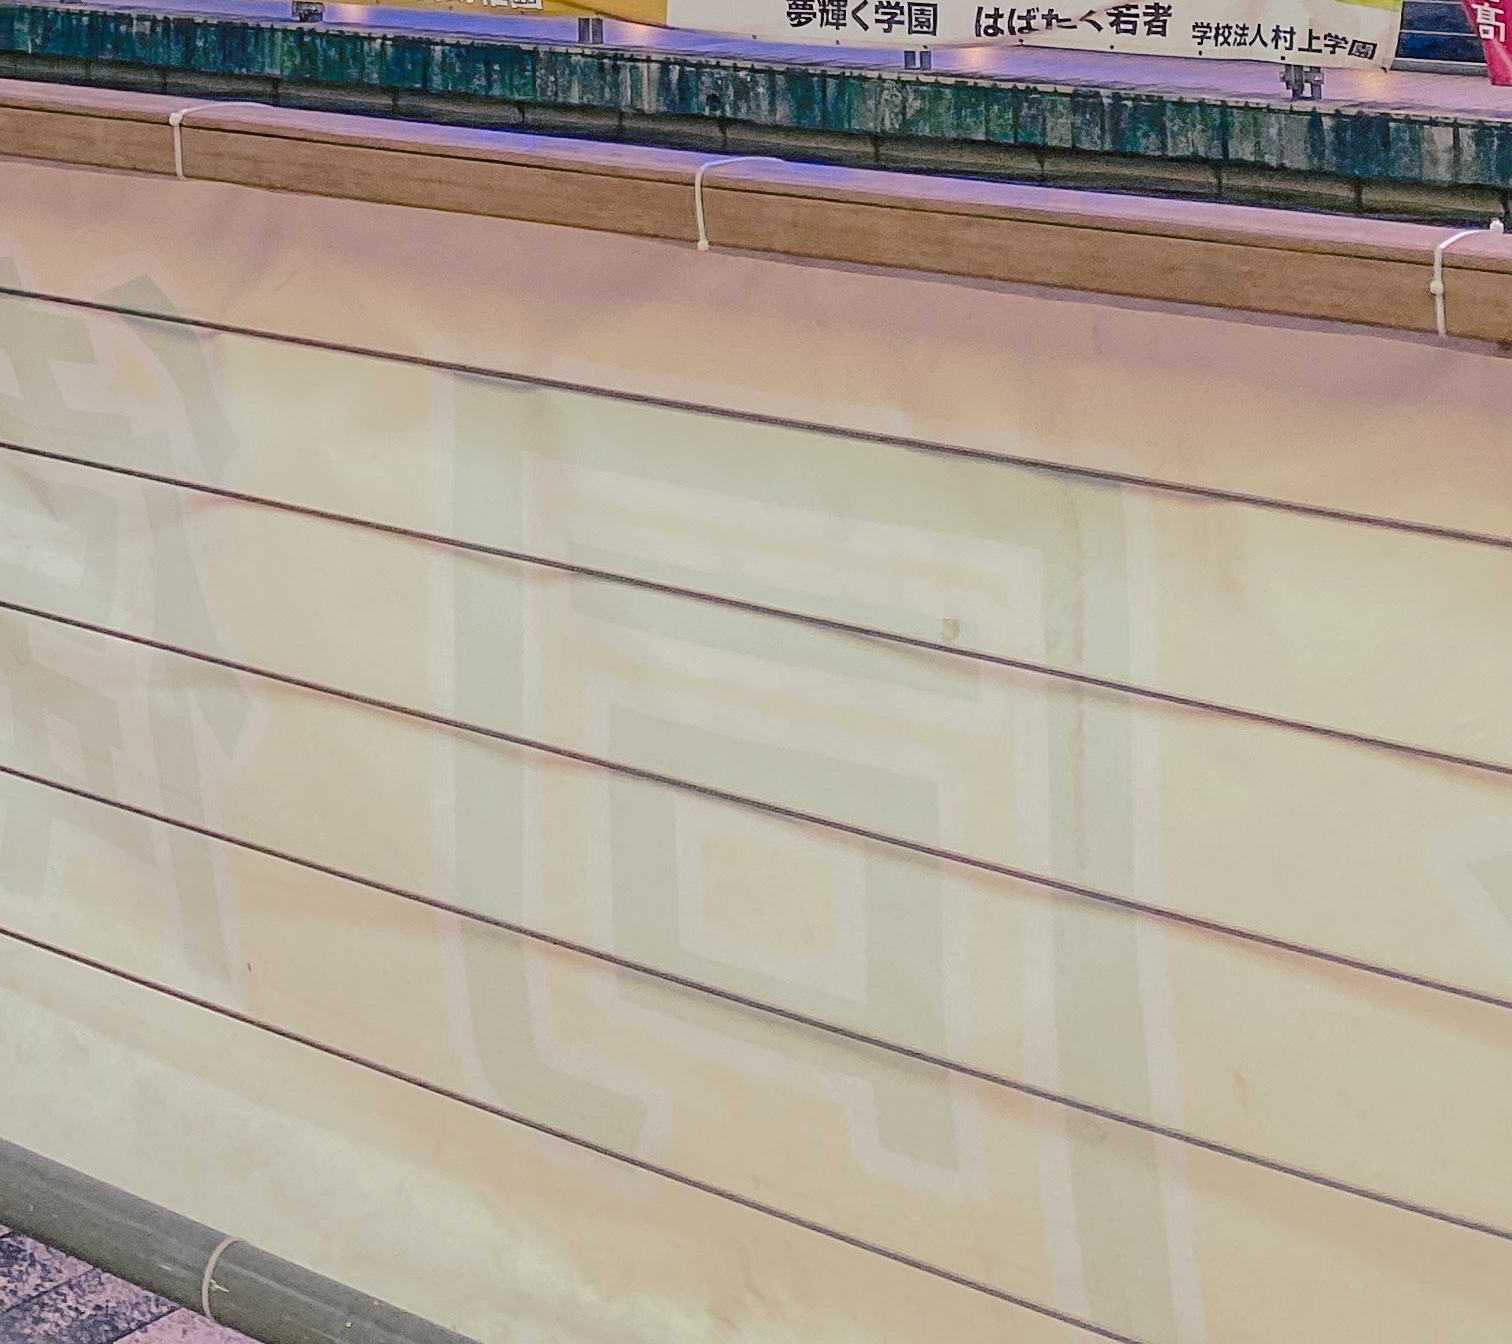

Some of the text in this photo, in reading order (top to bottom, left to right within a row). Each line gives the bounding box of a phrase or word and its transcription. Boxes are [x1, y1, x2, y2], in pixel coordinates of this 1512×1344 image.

[1192, 21, 1378, 60] 学校法人村上学園
